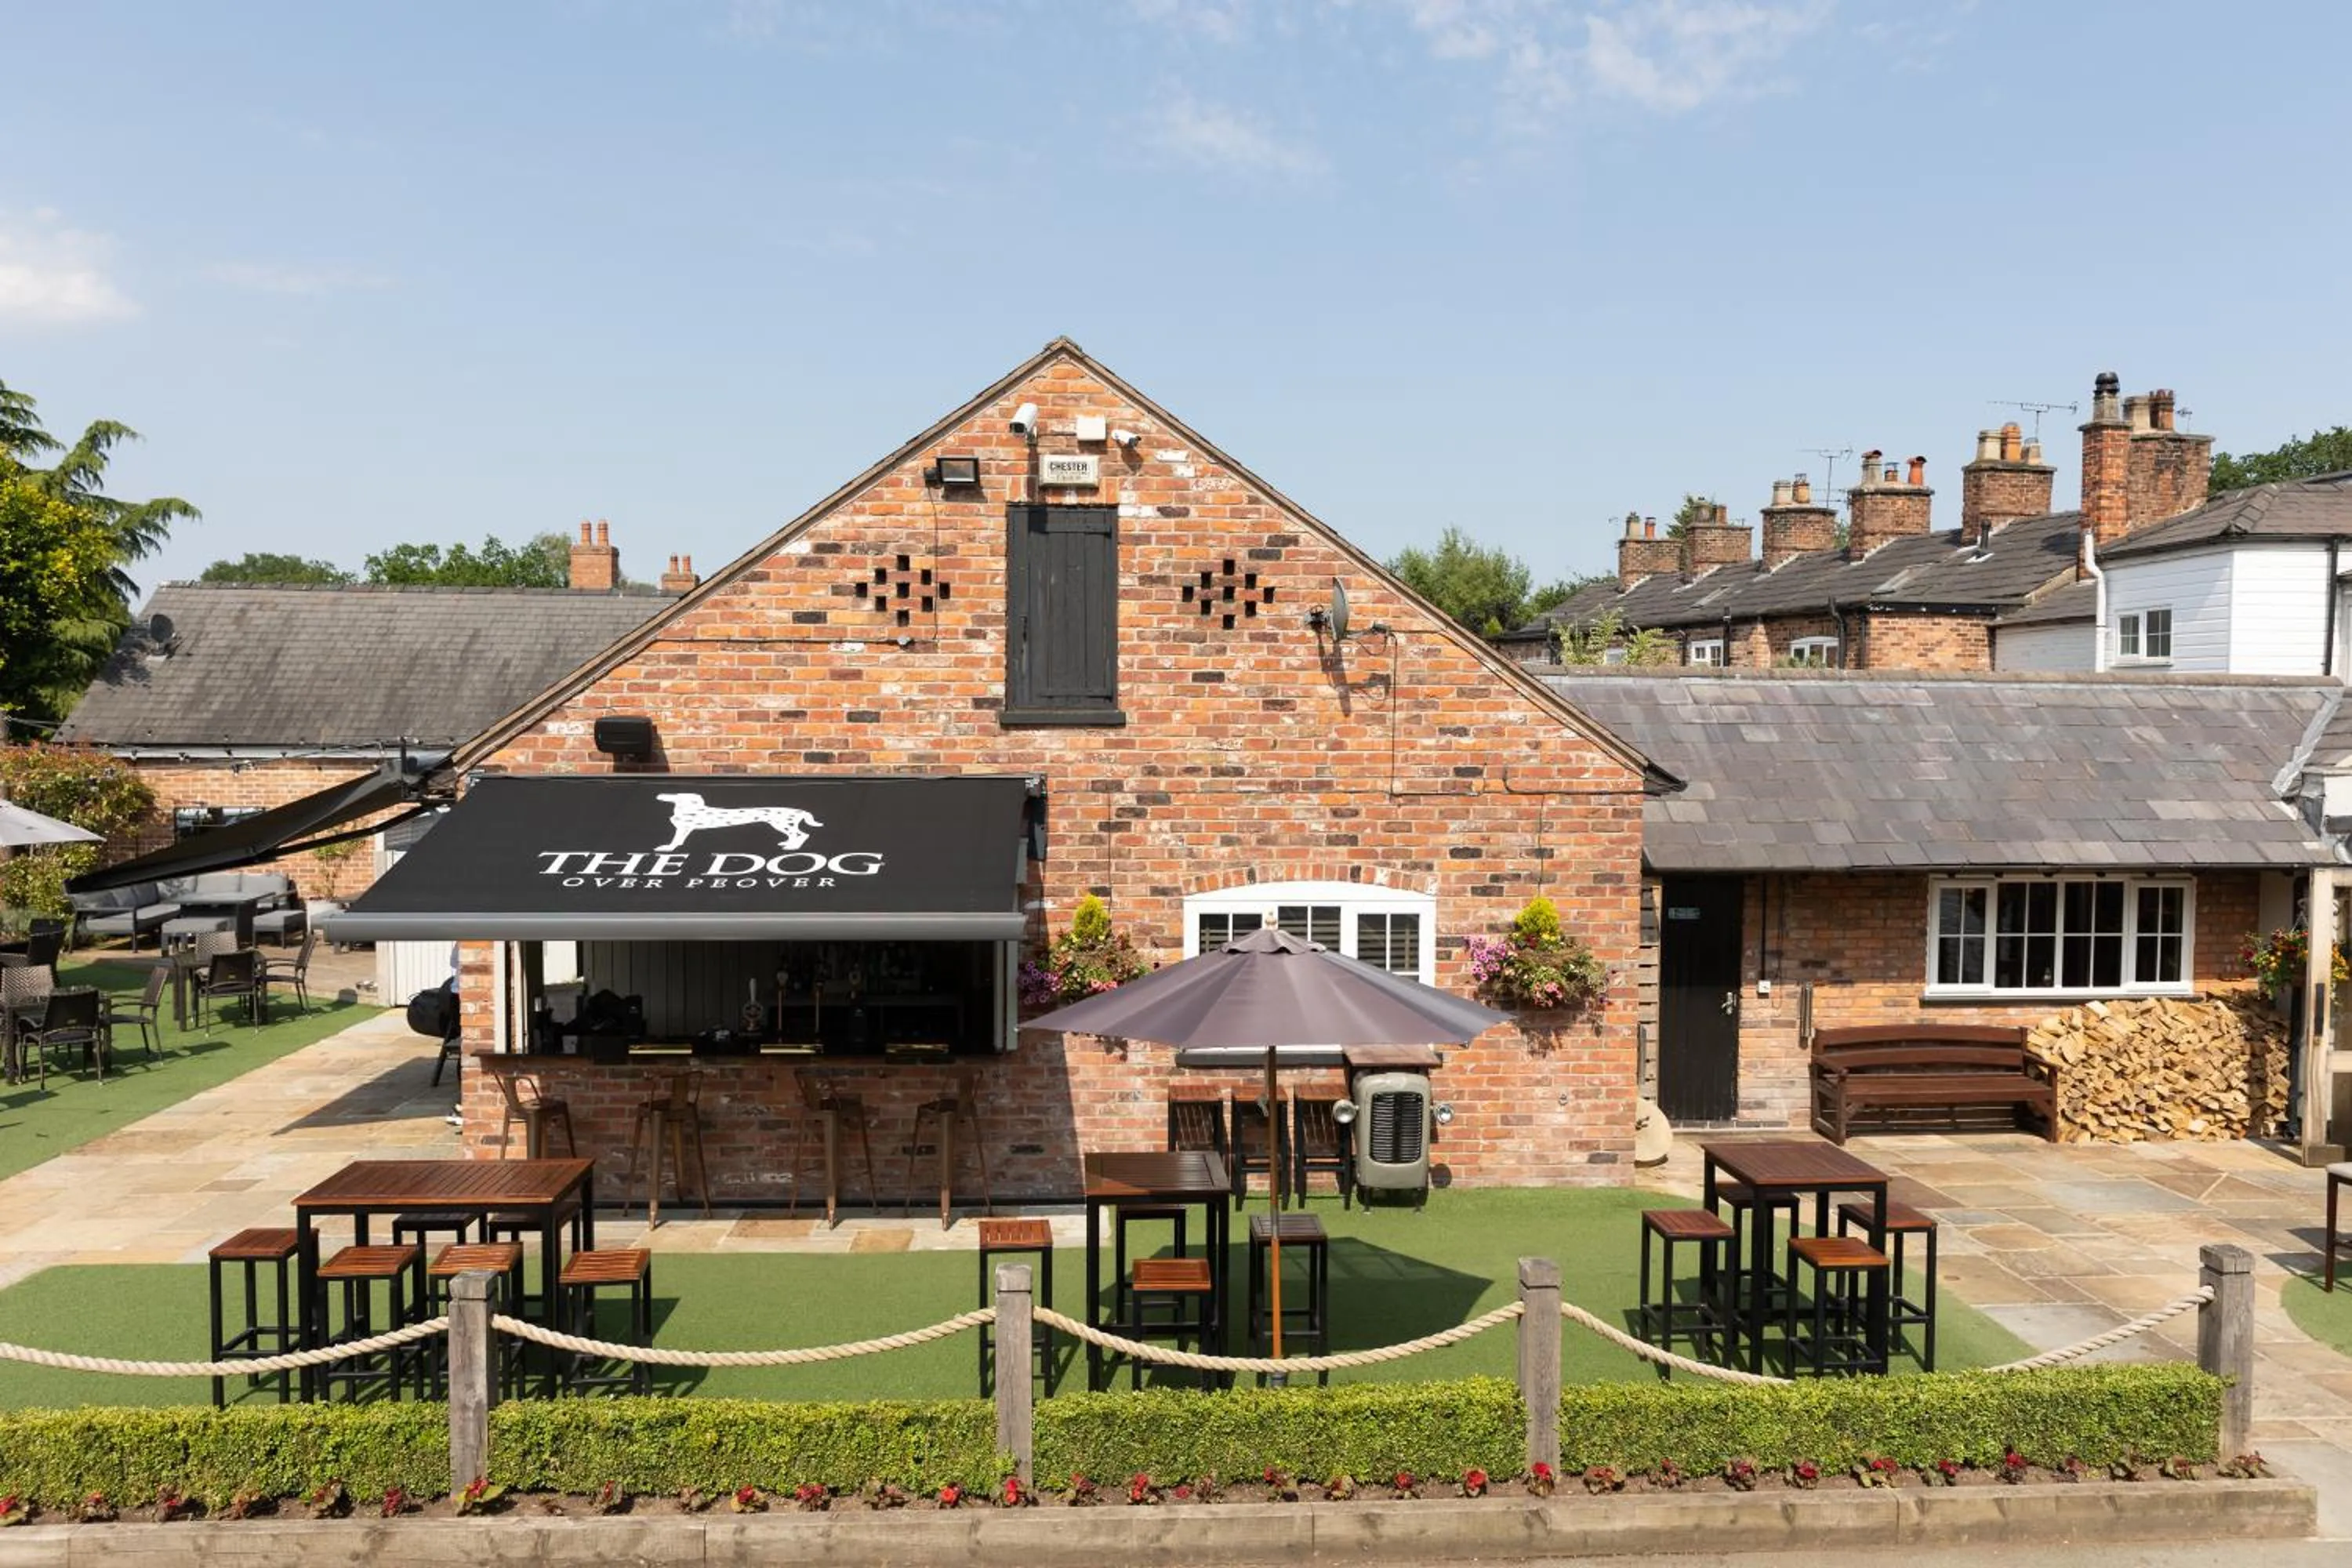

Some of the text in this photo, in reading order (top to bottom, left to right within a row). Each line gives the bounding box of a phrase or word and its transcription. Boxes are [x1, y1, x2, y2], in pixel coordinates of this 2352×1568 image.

[1050, 462, 1087, 471] CHESTER
[537, 851, 886, 877] THE DOG
[561, 877, 837, 889] OVER PEOVER
